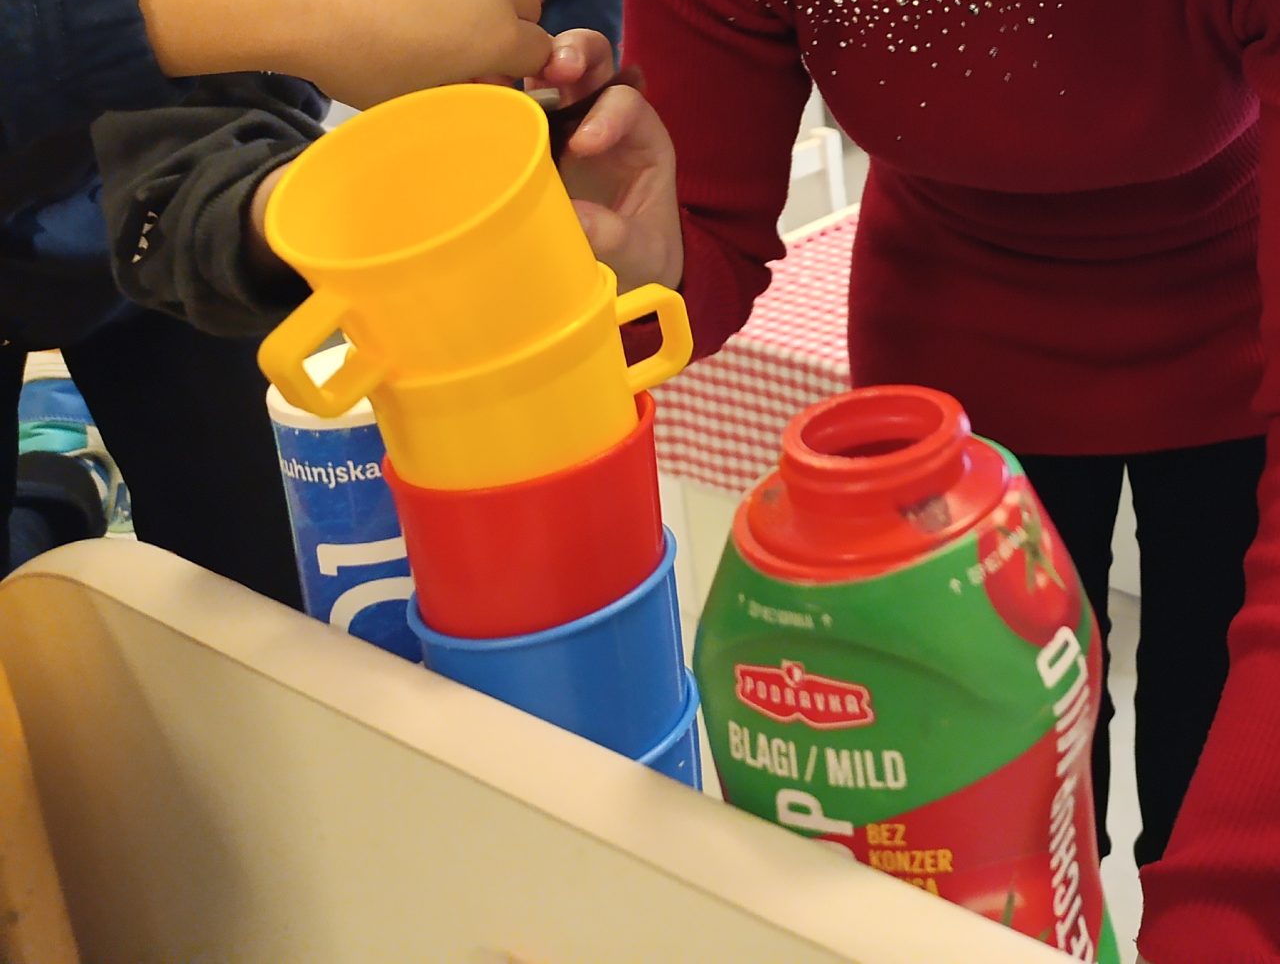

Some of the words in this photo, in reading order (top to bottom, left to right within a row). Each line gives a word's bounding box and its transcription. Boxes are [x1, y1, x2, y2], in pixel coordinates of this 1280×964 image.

[743, 675, 861, 715] PODRAVKA
[728, 720, 798, 780] BLAGI
[824, 746, 908, 790] MILD
[866, 823, 907, 846] BEZ
[869, 848, 954, 873] KONZER
